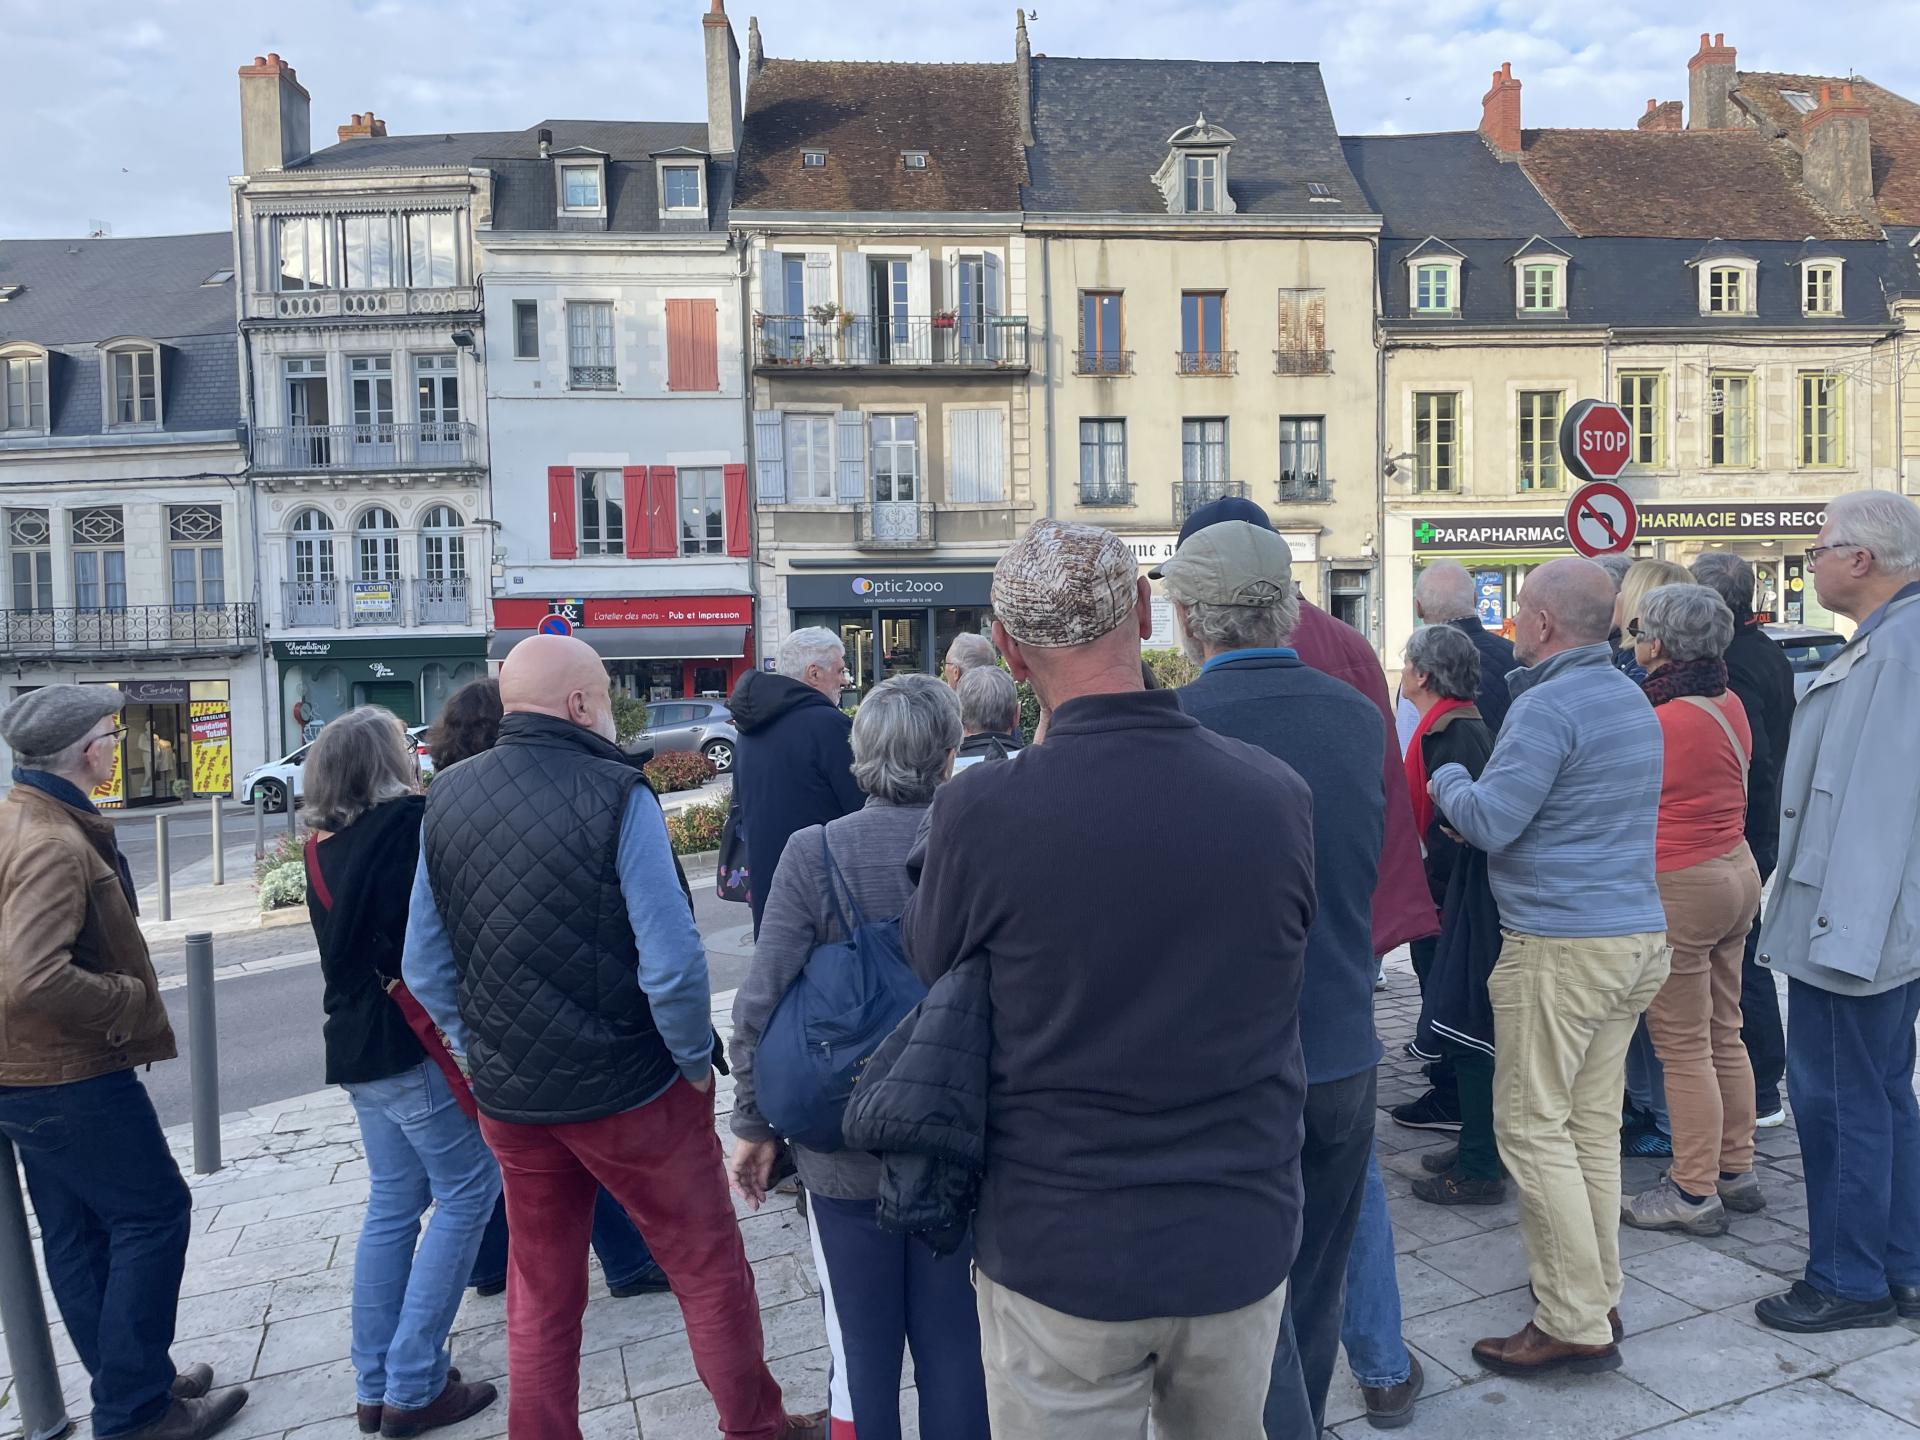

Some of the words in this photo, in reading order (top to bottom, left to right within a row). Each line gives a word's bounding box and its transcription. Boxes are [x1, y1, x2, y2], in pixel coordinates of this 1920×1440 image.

[1582, 430, 1627, 452] STOP
[1636, 512, 1736, 528] HARMACIE
[1740, 512, 1776, 527] DES
[1779, 511, 1829, 527] RECO
[1434, 527, 1567, 542] PARAPHARMAC
[862, 579, 903, 596] Optic
[905, 580, 944, 592] 2000
[594, 612, 623, 620] L'atelier
[624, 612, 639, 620] des
[668, 611, 684, 619] Pub
[698, 611, 740, 620] Impression
[285, 641, 330, 651] Chocolaterie
[191, 722, 228, 732] Liquidation
[205, 729, 227, 738] Totale
